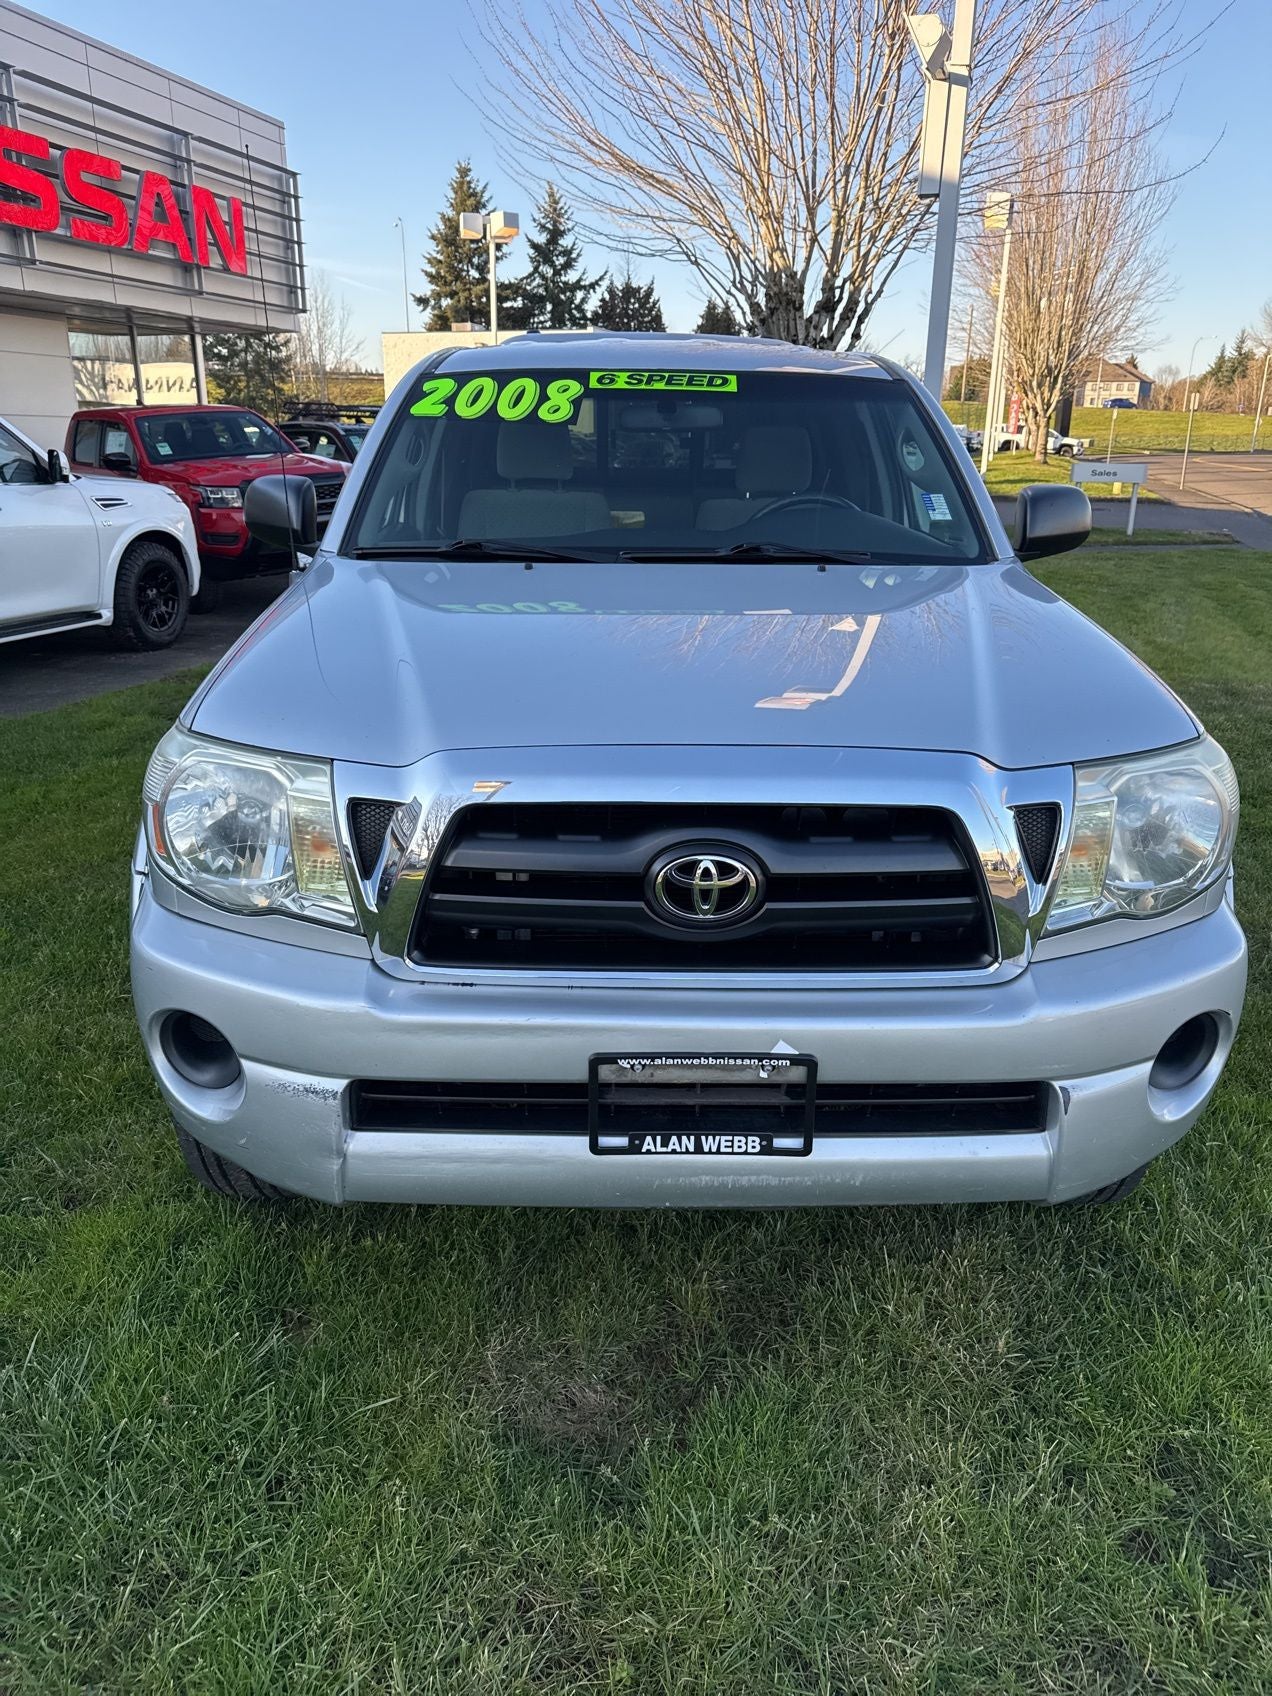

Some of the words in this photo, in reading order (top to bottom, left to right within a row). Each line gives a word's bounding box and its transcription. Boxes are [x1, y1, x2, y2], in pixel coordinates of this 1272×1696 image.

[596, 373, 620, 387] 6
[624, 373, 731, 388] SPEED
[410, 377, 584, 423] 2008
[1091, 469, 1118, 477] Sales
[617, 1057, 790, 1067] www.alanwebbnissan.com
[641, 1135, 694, 1153] ALAN
[701, 1136, 761, 1153] WEBB
